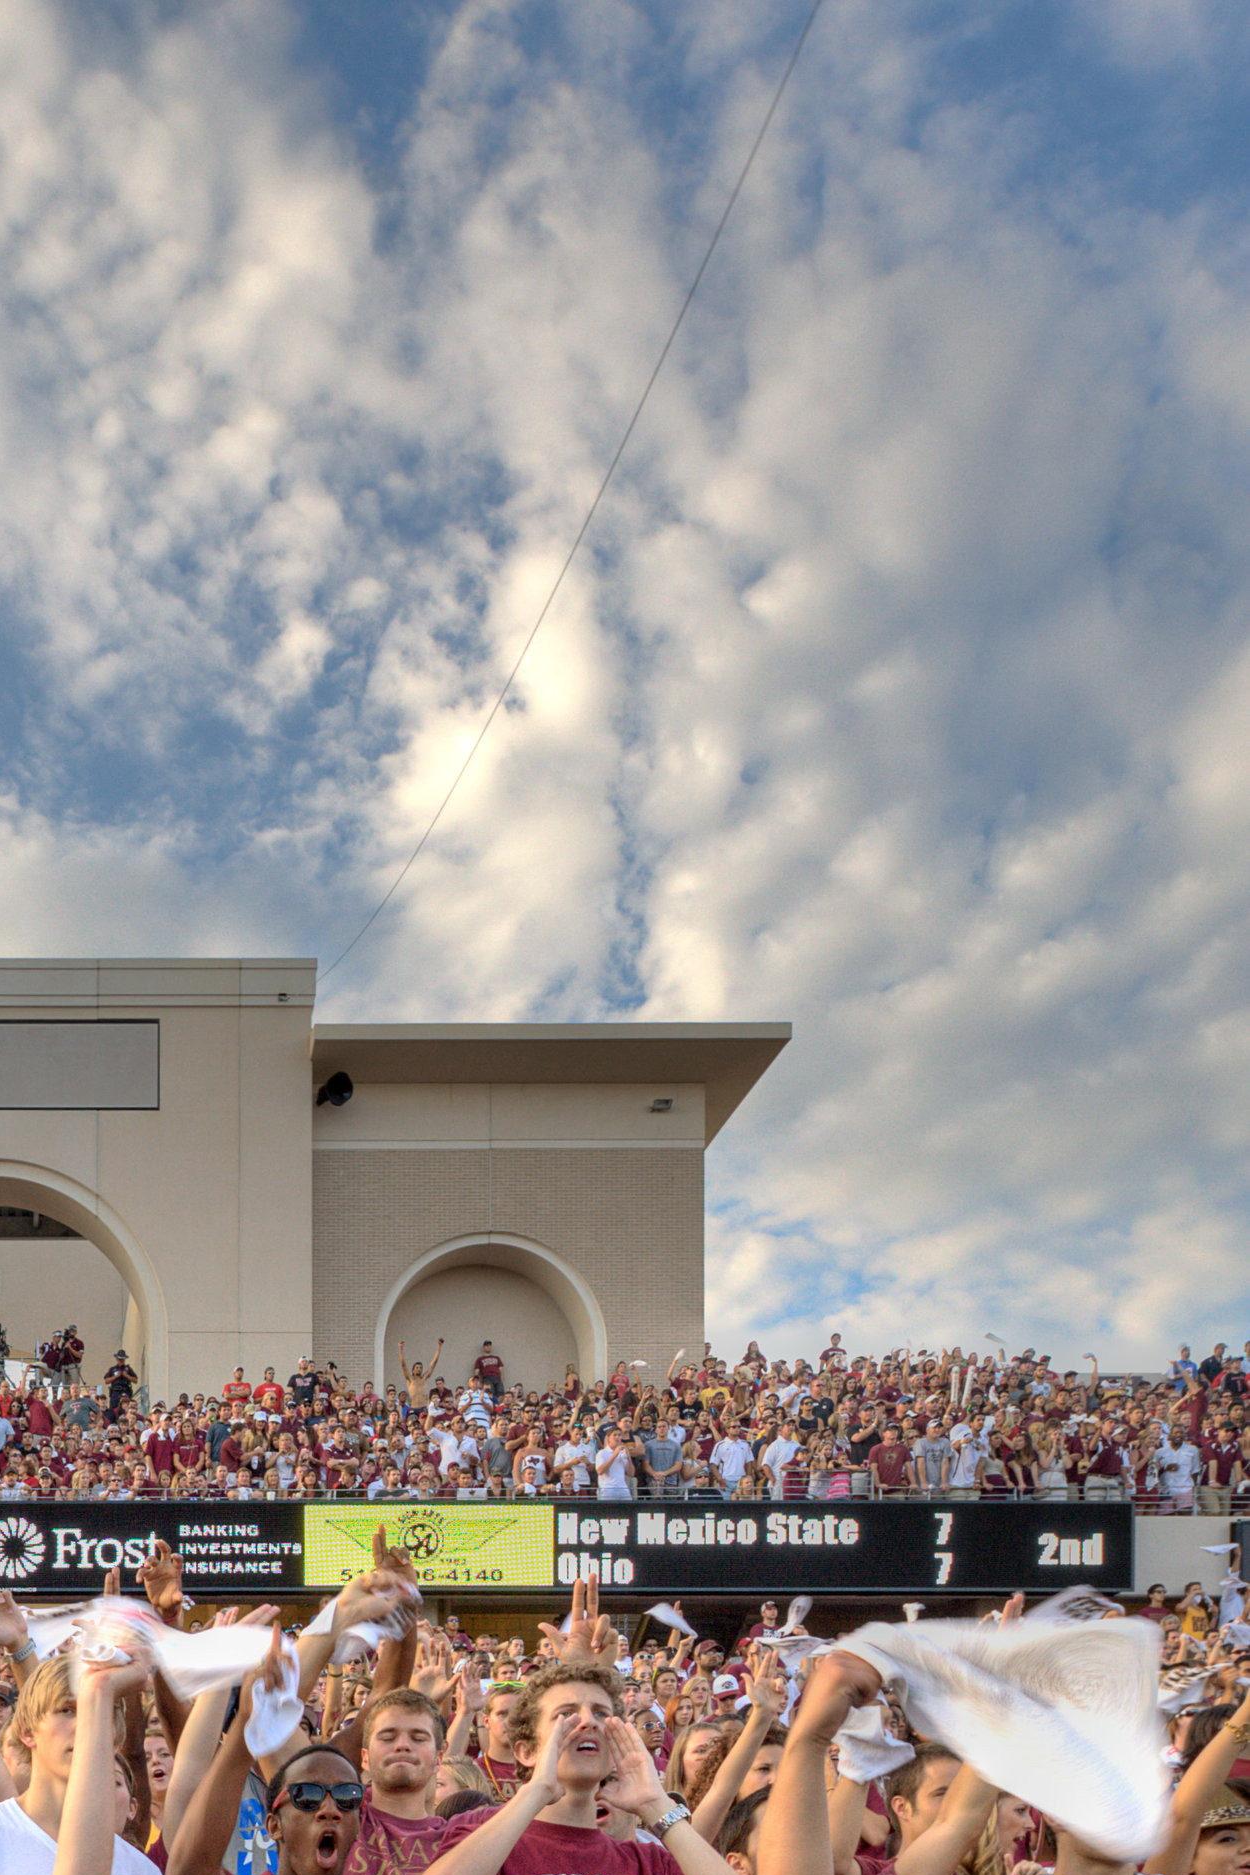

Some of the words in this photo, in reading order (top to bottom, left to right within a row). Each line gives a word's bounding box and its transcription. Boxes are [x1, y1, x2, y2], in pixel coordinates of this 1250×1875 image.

[179, 1524, 259, 1537] BANKING
[558, 1513, 629, 1545] New
[637, 1513, 758, 1545] Mexico
[766, 1513, 859, 1545] State
[934, 1513, 953, 1545] 7
[52, 1527, 161, 1569] Frost
[179, 1543, 302, 1555] INVESTMENTS
[1038, 1533, 1103, 1566] 2nd
[180, 1561, 283, 1574] NSURANCE
[558, 1553, 635, 1585] Ohio
[934, 1553, 953, 1585] 7
